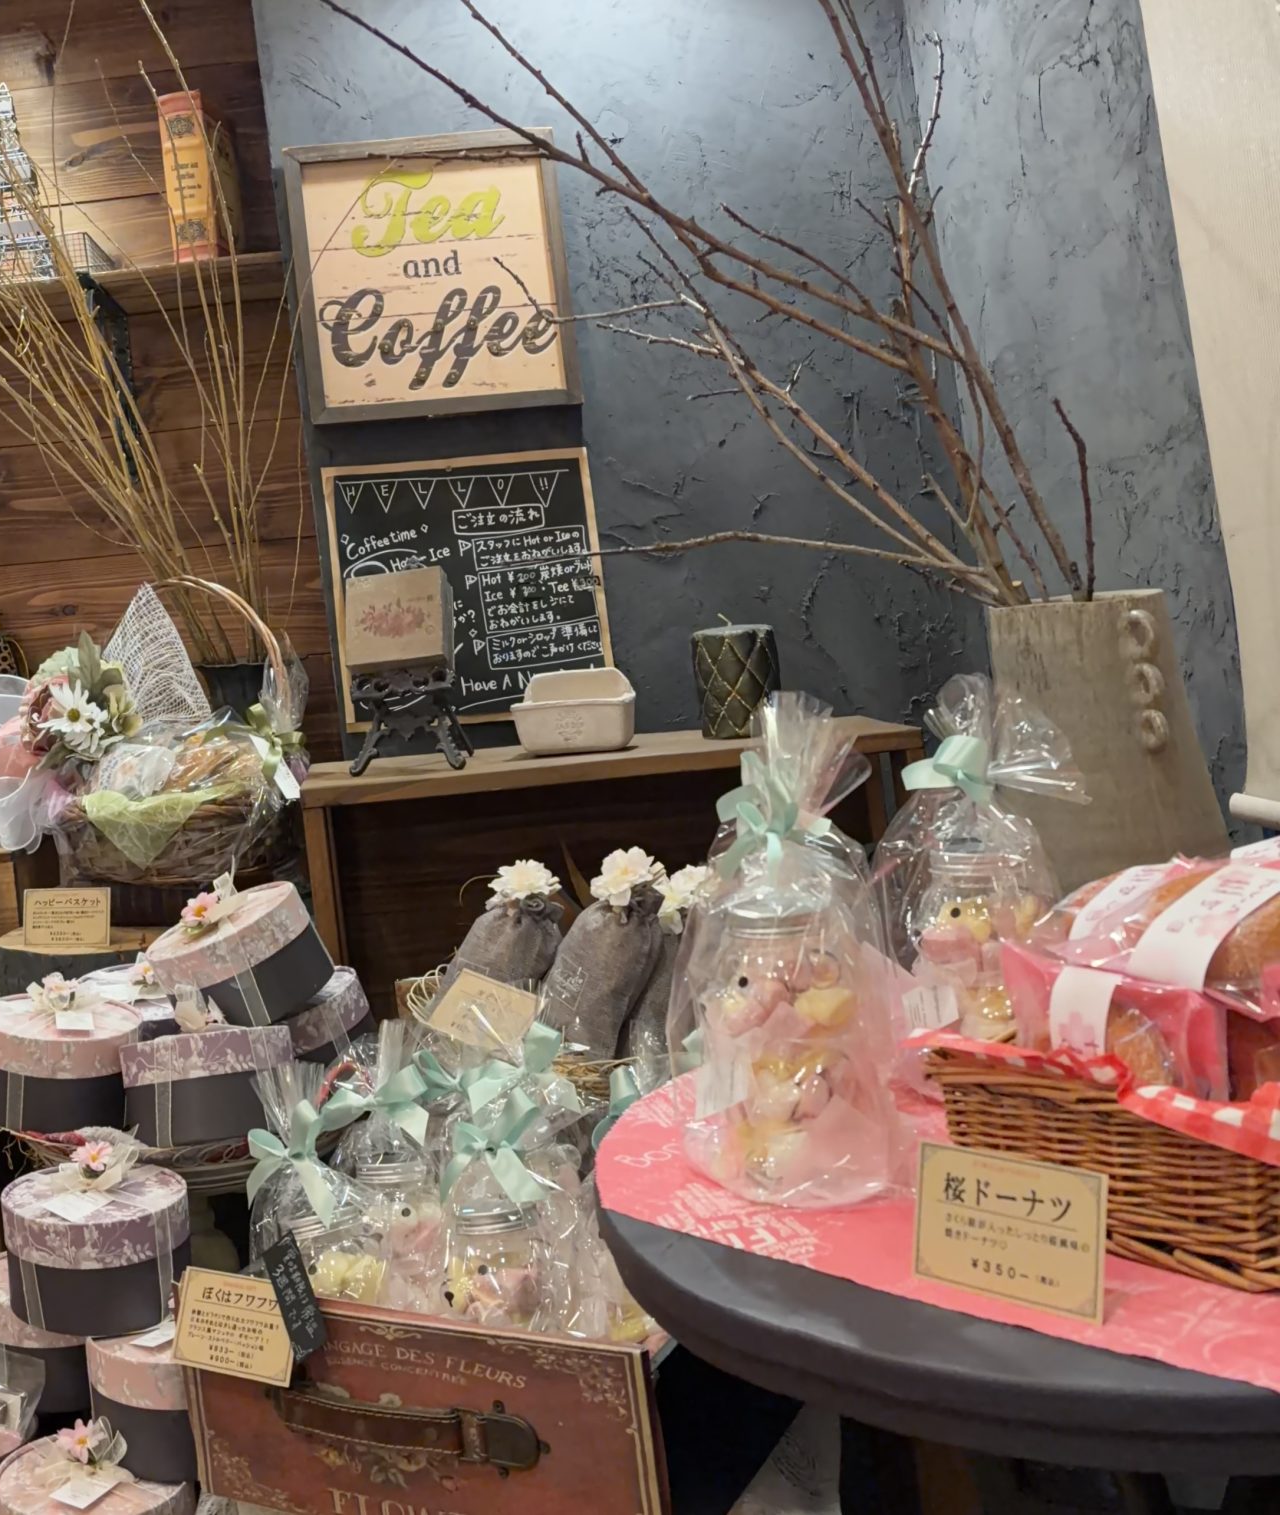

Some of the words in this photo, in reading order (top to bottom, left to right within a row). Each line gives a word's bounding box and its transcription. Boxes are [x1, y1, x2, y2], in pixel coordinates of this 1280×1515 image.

[351, 163, 506, 258] Tea
[403, 250, 462, 278] and
[319, 286, 558, 390] Coffee
[457, 507, 540, 529] ご注文の流れ
[428, 547, 451, 562] Ice
[476, 538, 520, 551] スタッフに
[523, 536, 540, 547] Hot
[482, 572, 501, 587] Hot
[484, 591, 504, 602] Ice
[461, 676, 498, 697] Have
[502, 673, 512, 690] A
[943, 1172, 1072, 1223] 桜ドーナツ
[396, 1345, 436, 1366] DES
[445, 1356, 528, 1390] FLEURS
